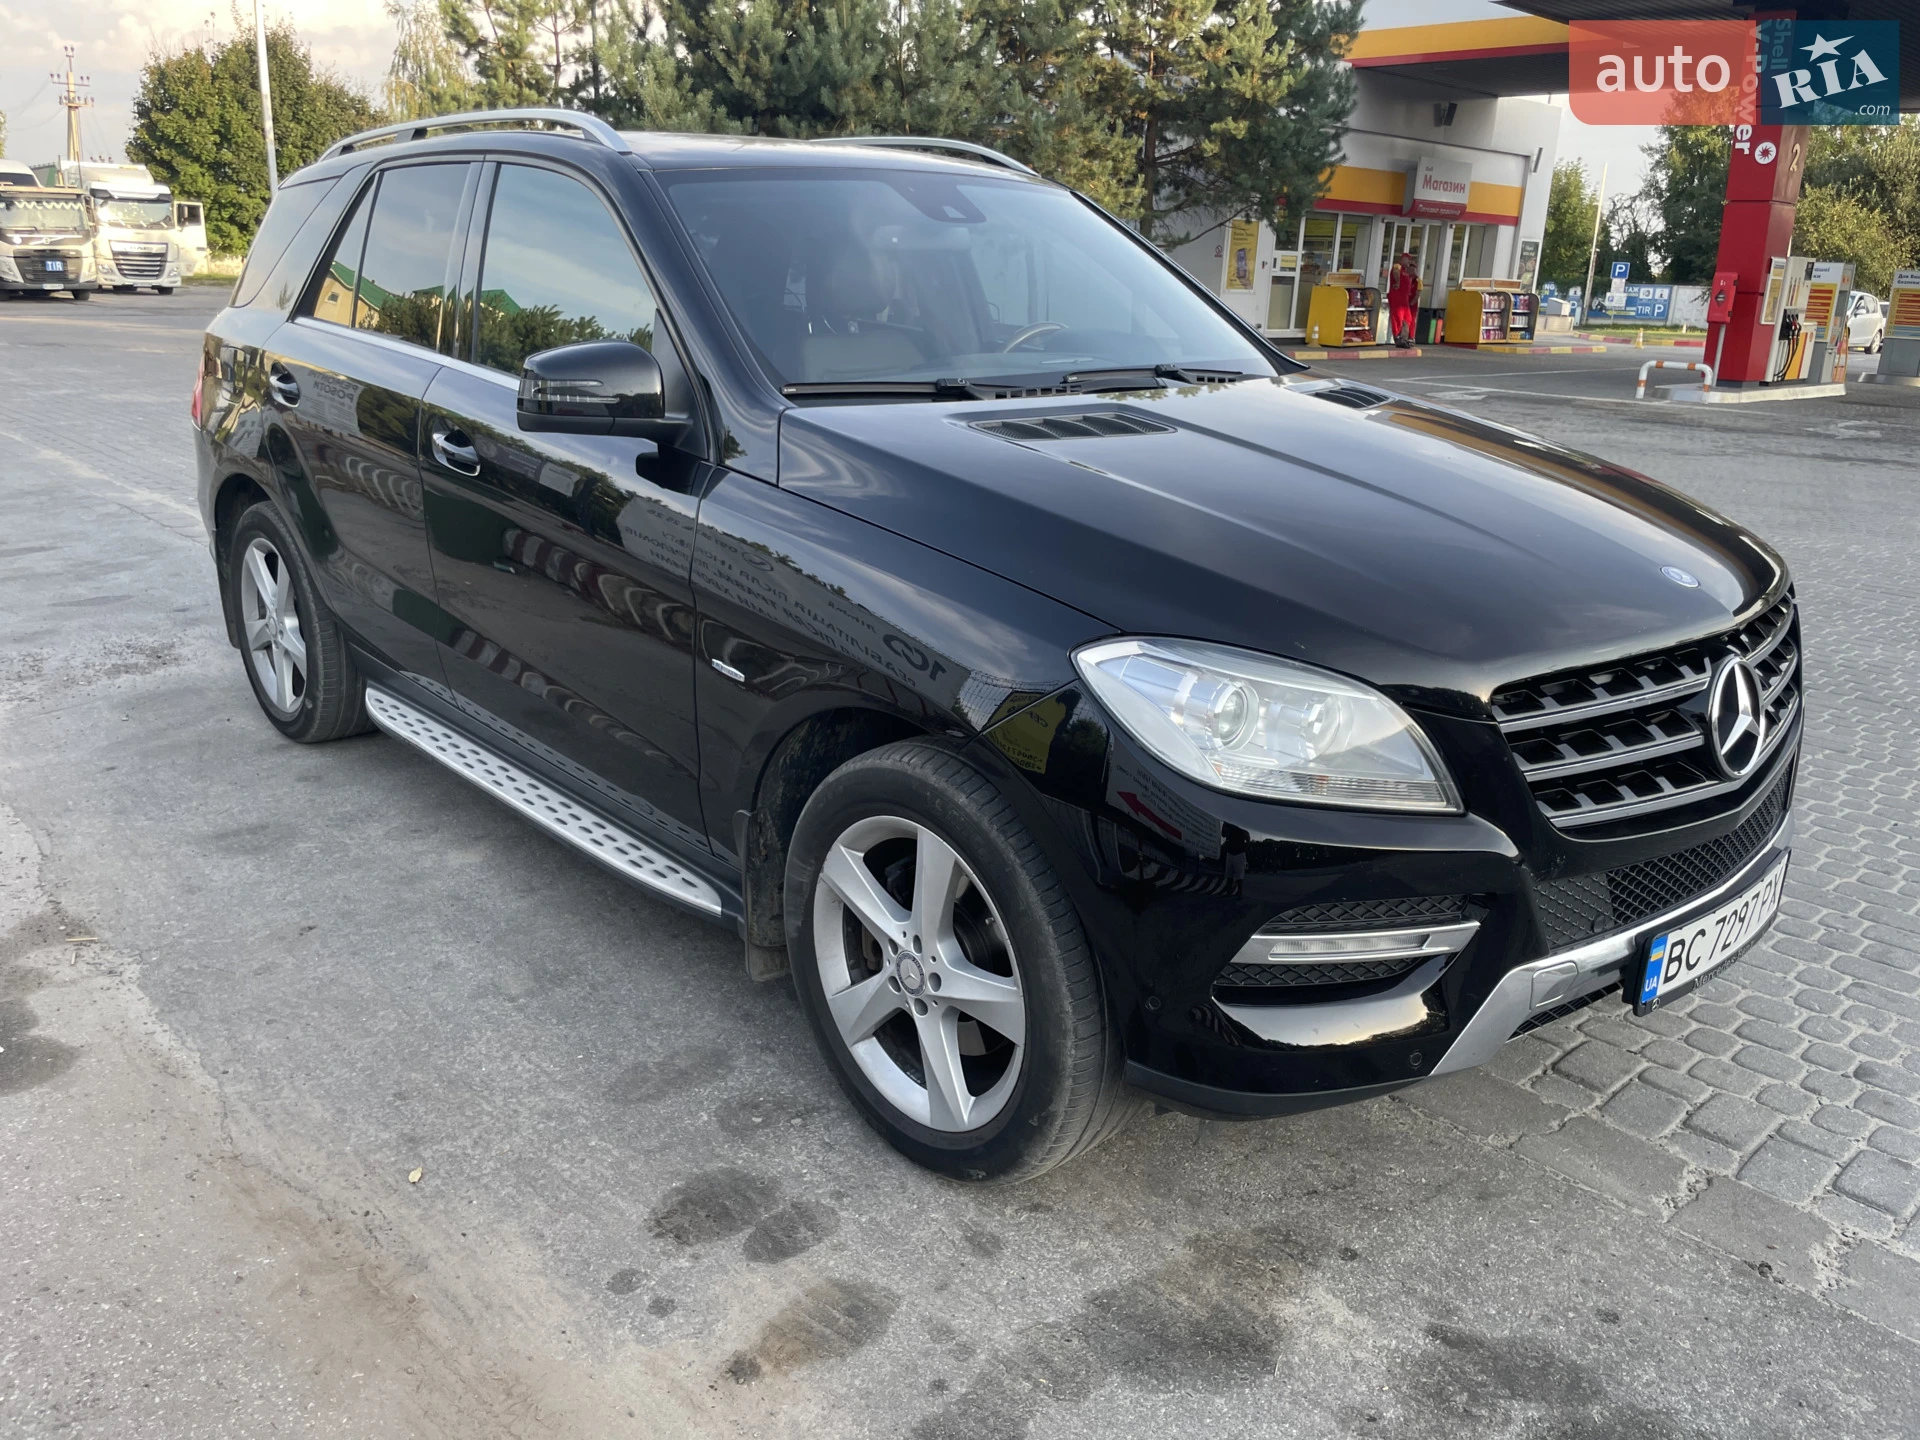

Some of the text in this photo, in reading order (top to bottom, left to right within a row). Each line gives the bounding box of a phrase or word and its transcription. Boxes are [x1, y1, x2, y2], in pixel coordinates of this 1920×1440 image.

[1770, 18, 1791, 71] Shell
[1734, 20, 1773, 155] V-Power
[1422, 174, 1466, 194] Магазин
[47, 261, 63, 271] TIR
[1615, 264, 1626, 277] P
[1637, 303, 1664, 317] TIR P
[1663, 928, 1706, 985] BC
[1709, 891, 1760, 960] 7297
[1644, 977, 1658, 992] UA
